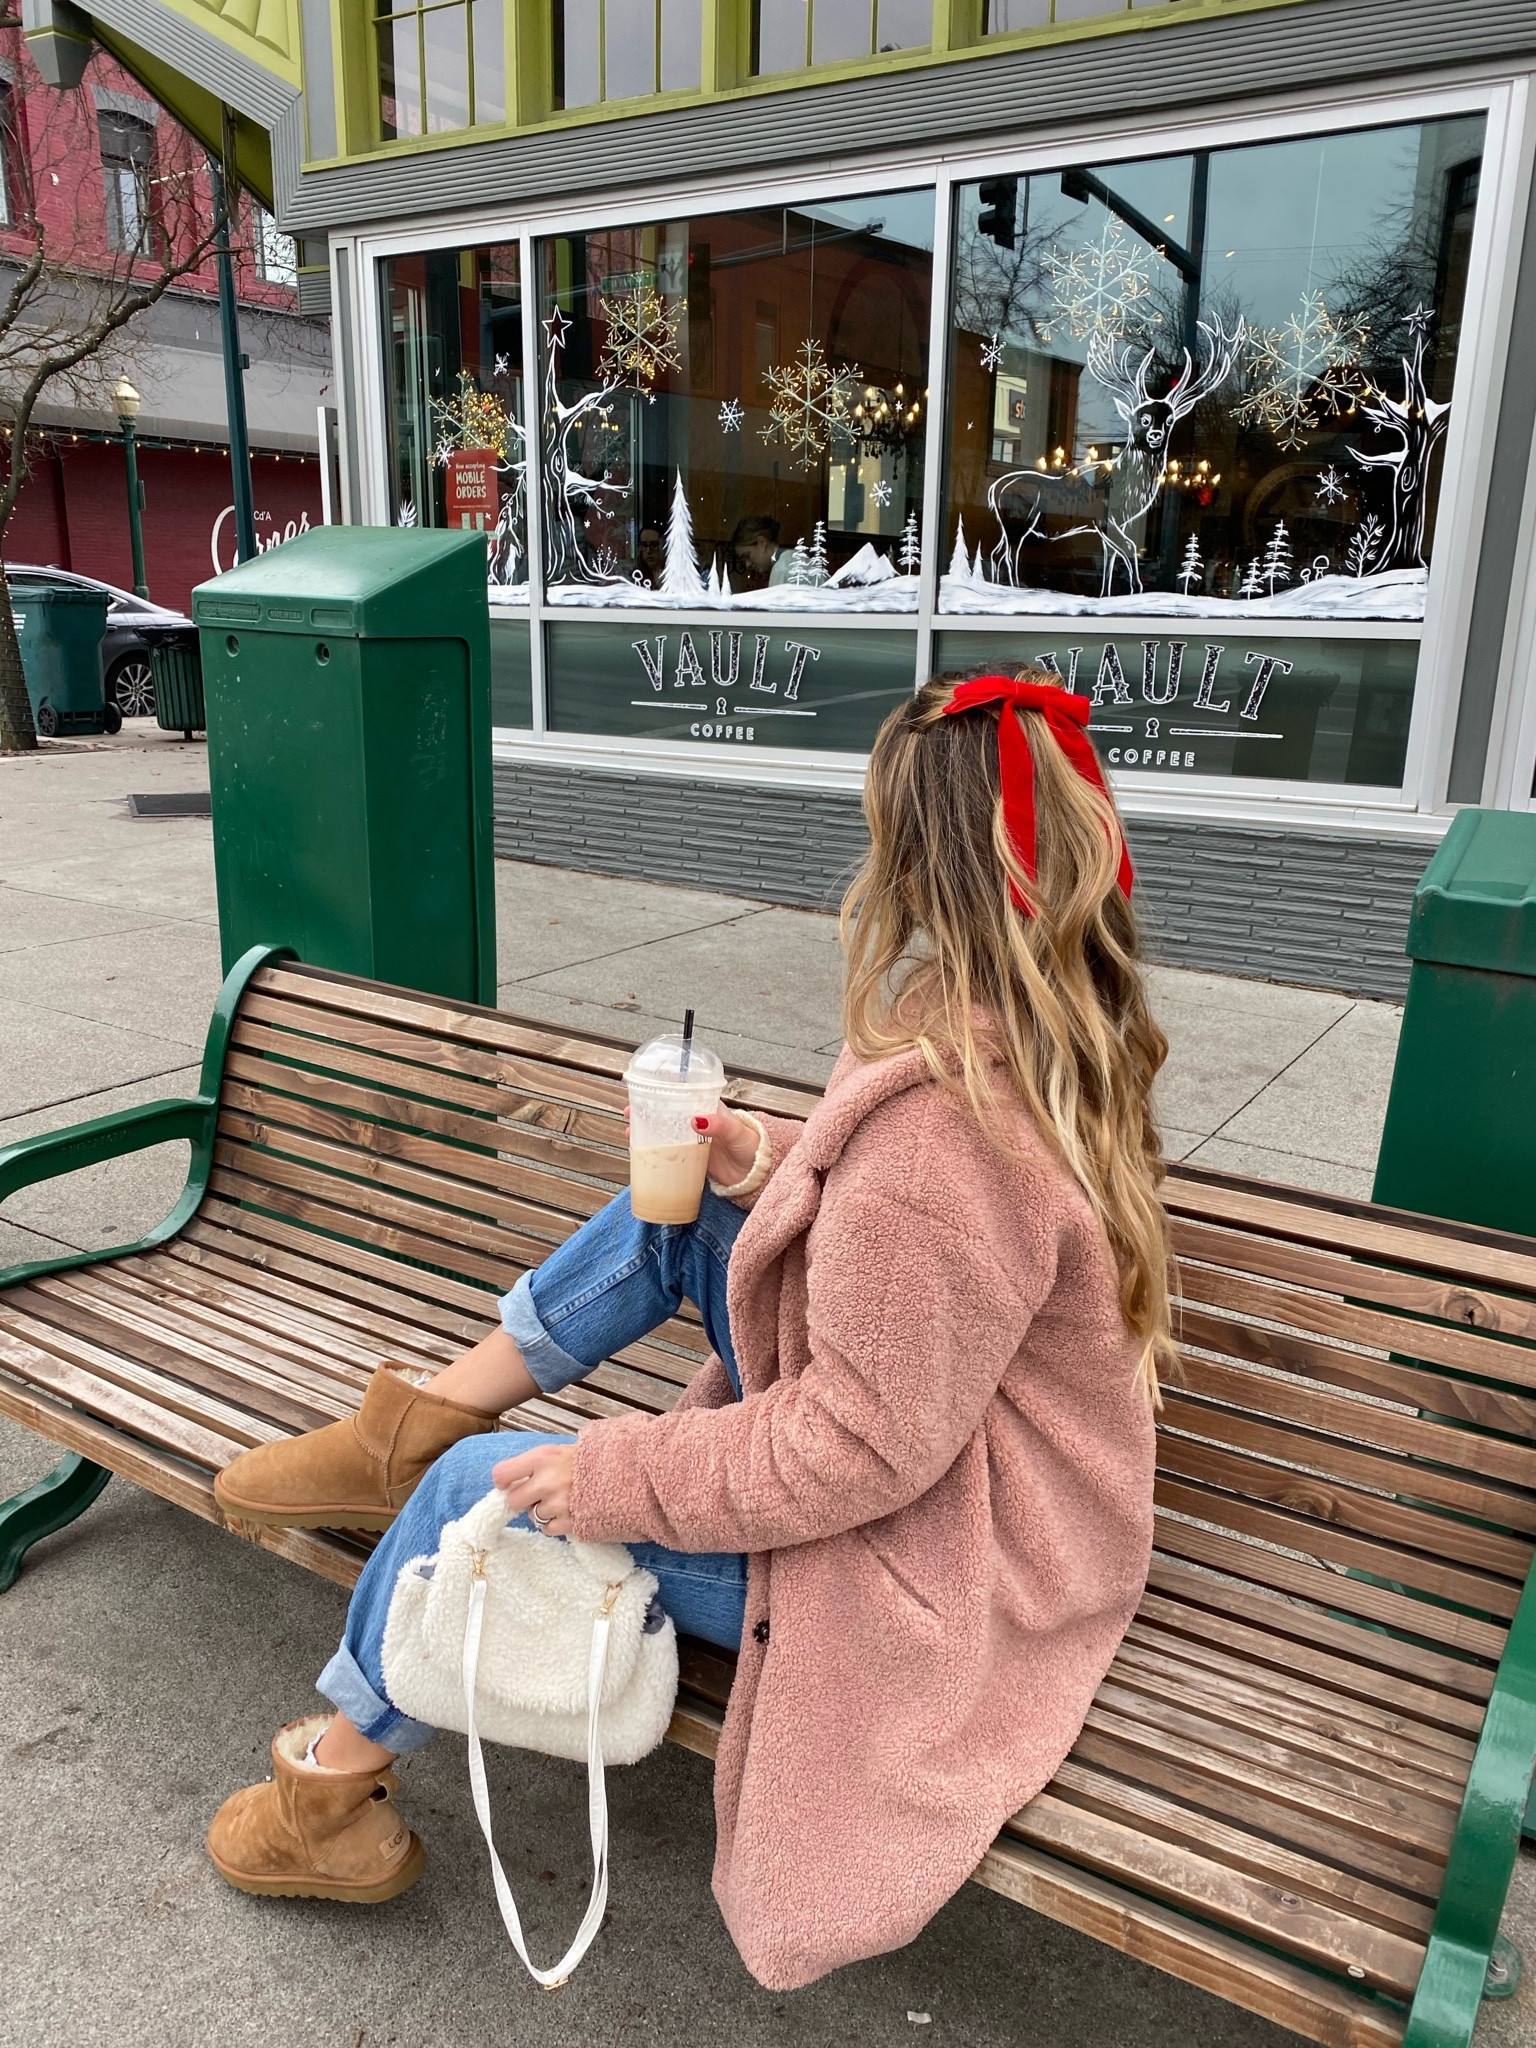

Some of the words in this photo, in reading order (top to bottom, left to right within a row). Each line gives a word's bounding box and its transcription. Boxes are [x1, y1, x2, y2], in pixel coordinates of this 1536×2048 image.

[456, 471, 486, 485] MOBILE
[456, 485, 487, 499] ORDERS
[253, 510, 272, 521] Cd'A
[632, 630, 821, 700] VAULT
[690, 723, 755, 741] COFFEE
[1108, 747, 1196, 767] COFFEE
